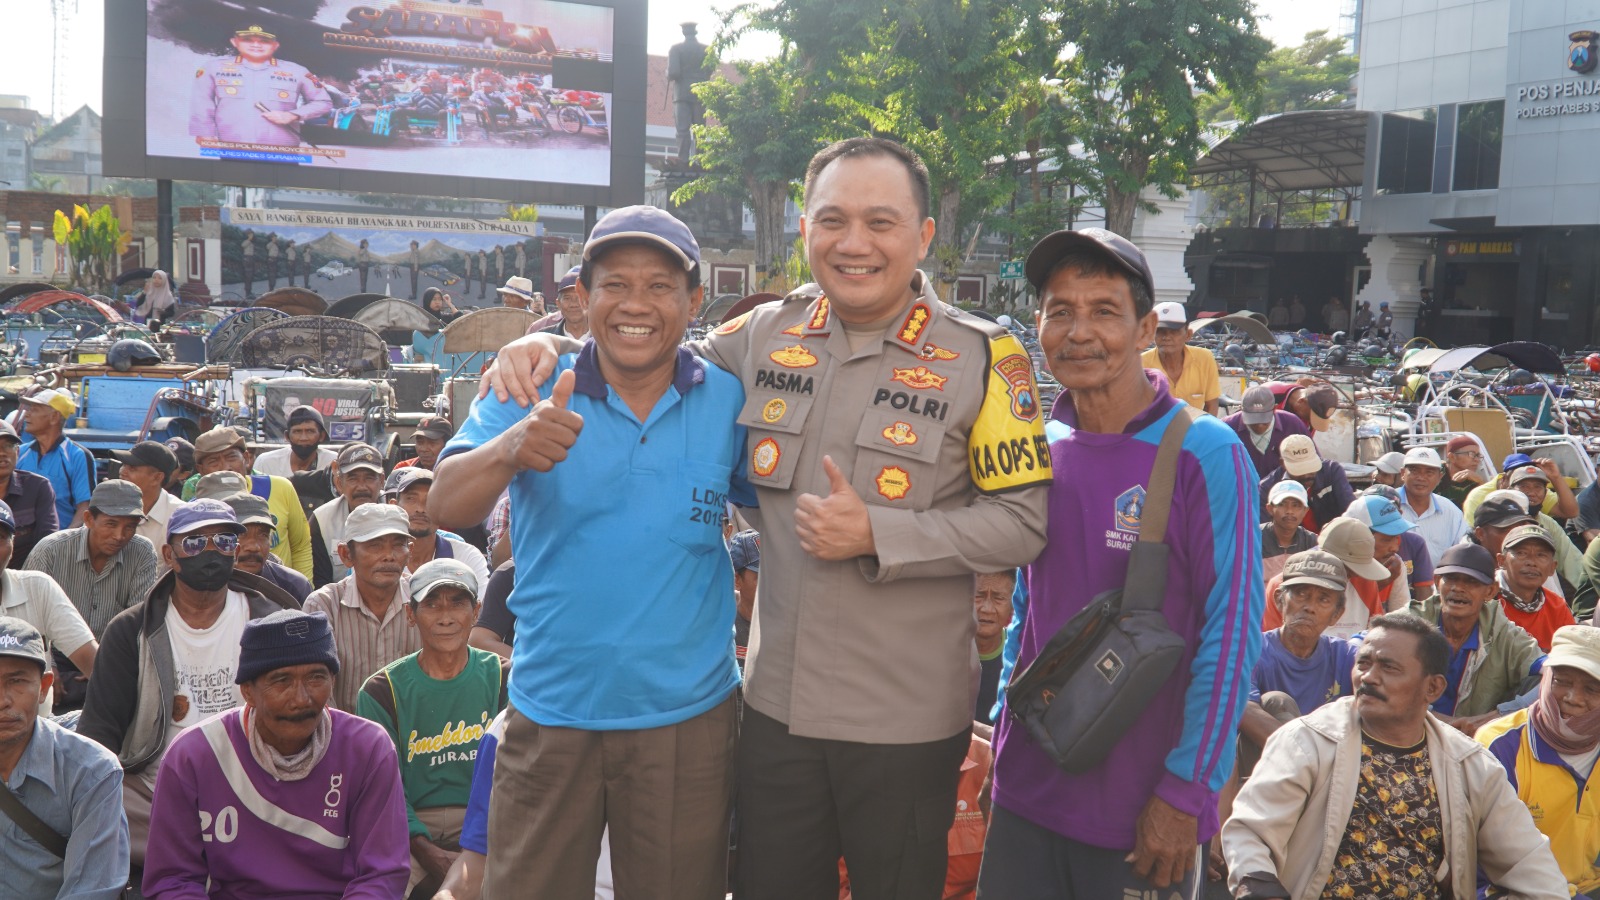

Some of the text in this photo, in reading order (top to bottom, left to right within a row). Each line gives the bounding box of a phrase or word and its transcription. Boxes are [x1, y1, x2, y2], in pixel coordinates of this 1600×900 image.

[1517, 85, 1549, 101] POS
[1516, 102, 1591, 118] POLRESTABES
[267, 153, 306, 161] SURABAYA
[237, 212, 529, 233] SAYA BANGGA SEBAGAI BHAYANGKARA POLRESTABES SURABAYA
[755, 369, 814, 395] PASMA
[312, 398, 336, 417] NO
[333, 407, 366, 416] JUSTICE
[337, 399, 360, 408] VIRAL
[874, 388, 949, 421] POLRI
[352, 425, 363, 439] 5
[973, 444, 998, 480] KA
[998, 437, 1035, 475] OPS
[692, 487, 728, 508] LDKS
[1106, 530, 1122, 540] SMK
[323, 808, 339, 818] FCG
[199, 805, 238, 843] 20
